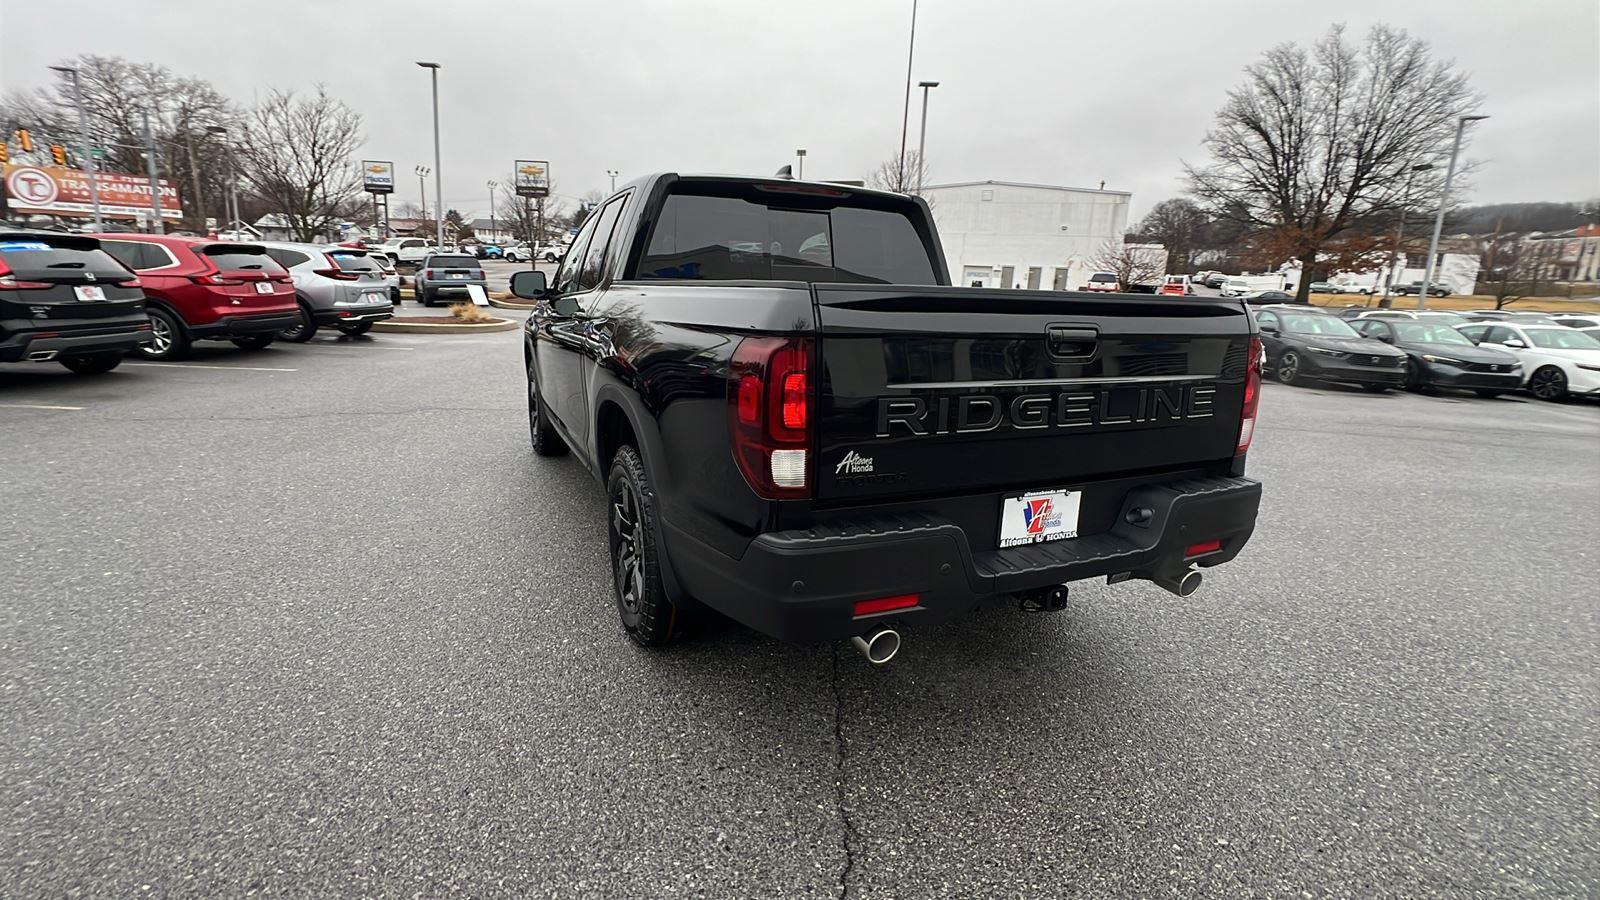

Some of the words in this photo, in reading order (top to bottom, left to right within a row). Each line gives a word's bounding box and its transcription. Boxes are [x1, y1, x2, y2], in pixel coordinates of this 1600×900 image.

[876, 386, 1216, 437] RIDGELINE
[851, 464, 873, 473] Honda
[1000, 537, 1033, 548] Altoona
[1046, 531, 1078, 541] HONDA
